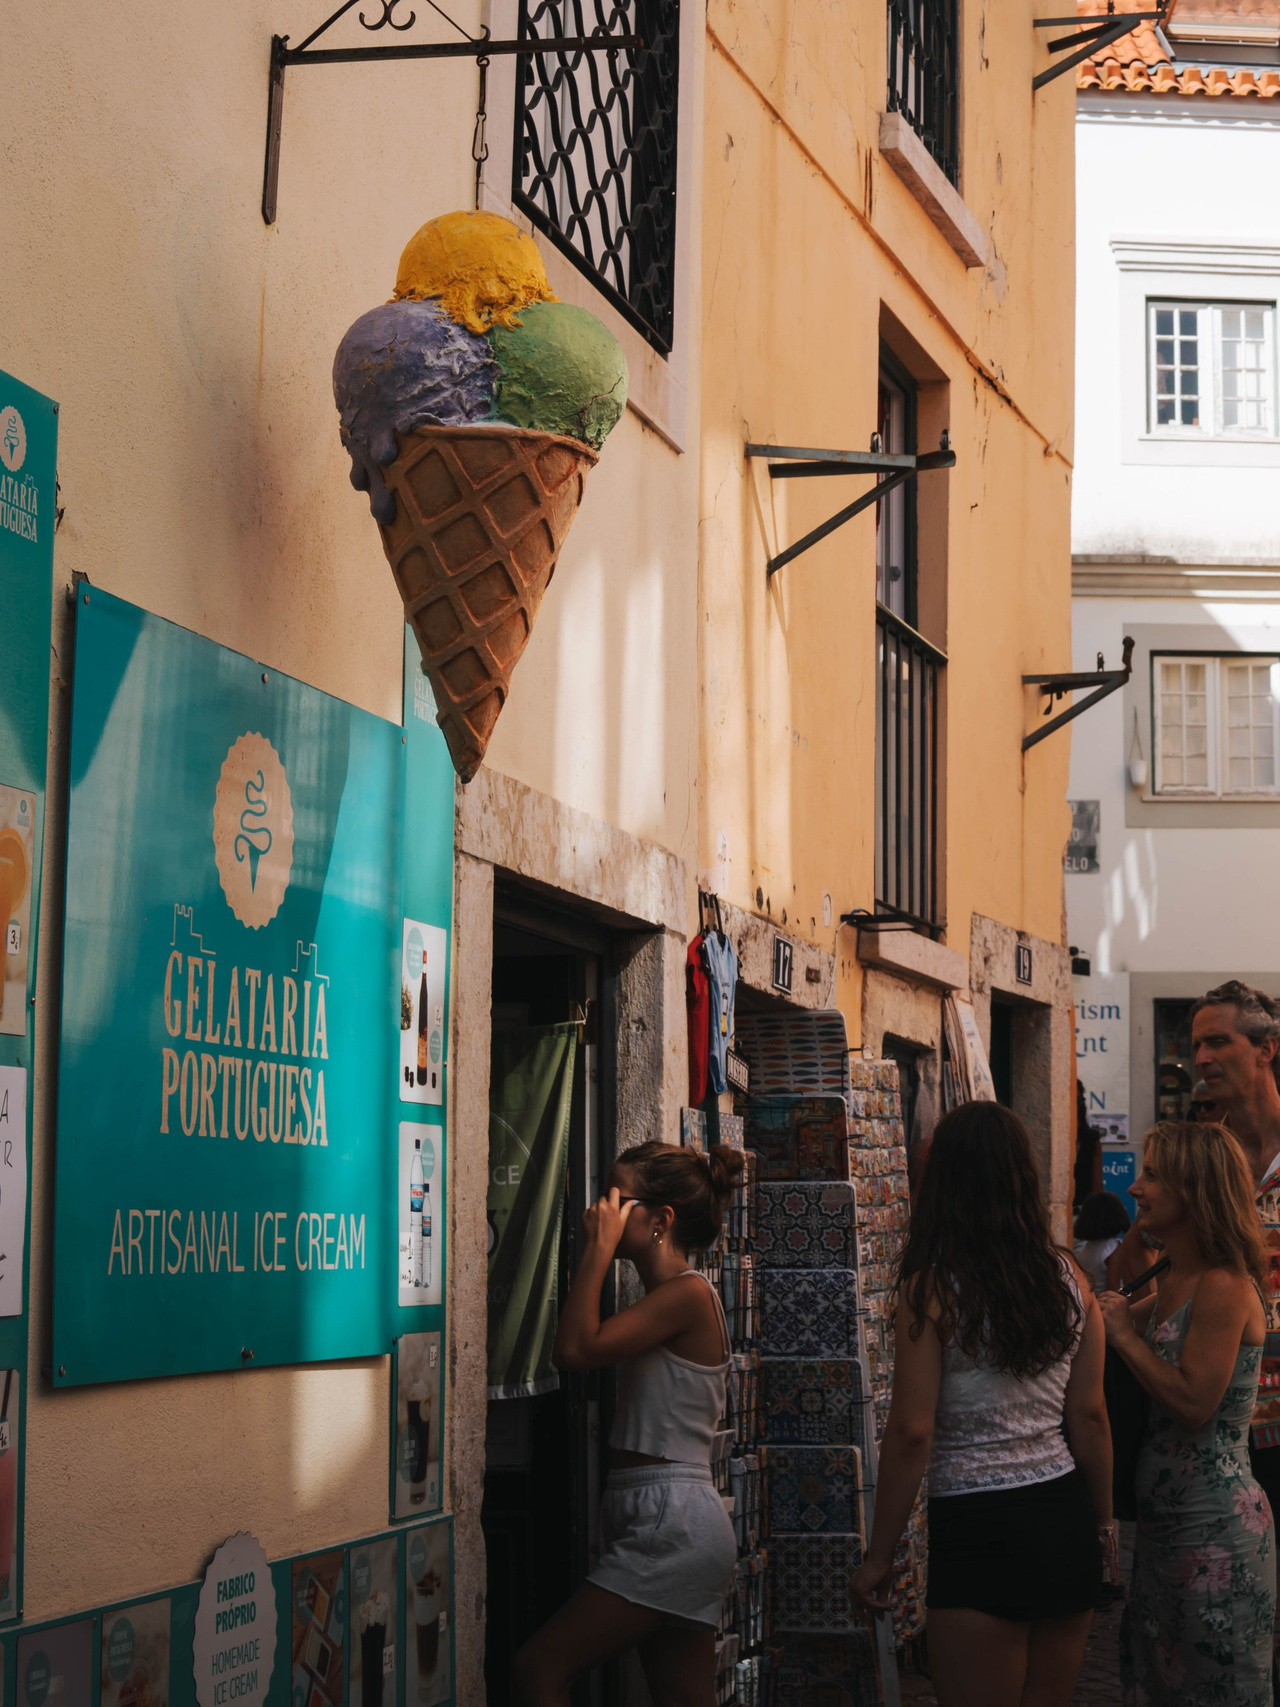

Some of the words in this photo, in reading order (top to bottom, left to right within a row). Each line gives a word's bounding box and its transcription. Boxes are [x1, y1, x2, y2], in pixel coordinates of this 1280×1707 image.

[778, 942, 791, 987] 17
[1018, 945, 1031, 981] 19
[164, 950, 329, 1060] GELATARIA
[1075, 999, 1121, 1020] ism
[160, 1047, 329, 1147] PORTUGUESA
[107, 1209, 245, 1275] ARTISANAL
[254, 1212, 287, 1271] ICE
[295, 1213, 366, 1271] CREAM
[217, 1571, 256, 1604] FABRICO
[215, 1602, 257, 1635] PRÓPRIO
[211, 1638, 260, 1676] HOMEMADE
[213, 1678, 228, 1706] ICE
[229, 1669, 258, 1700] CREAM
